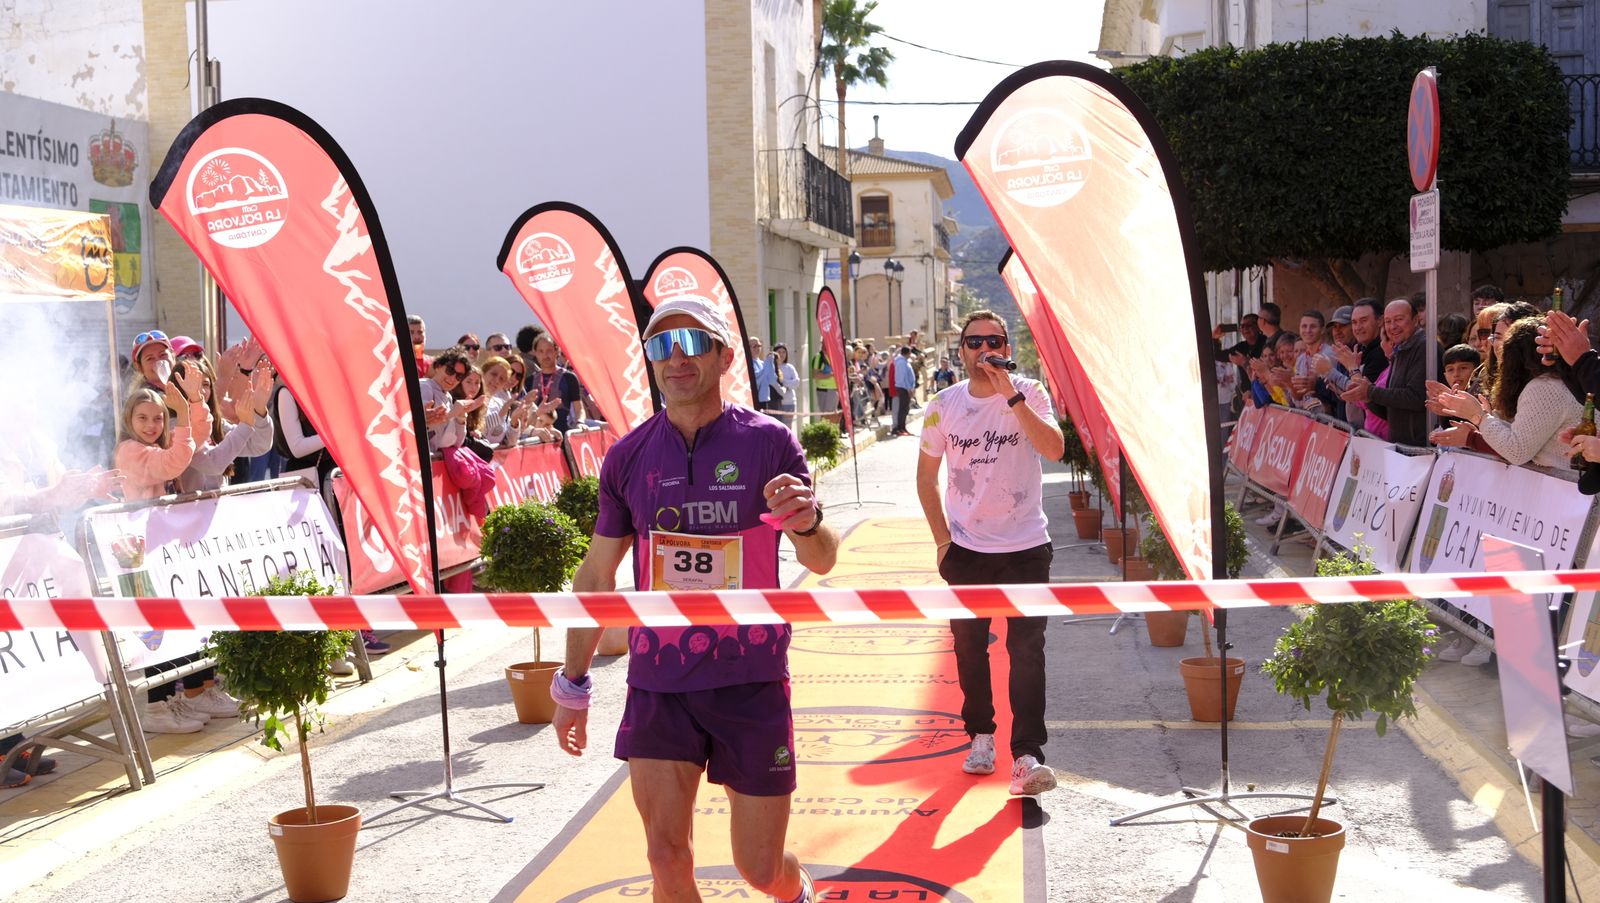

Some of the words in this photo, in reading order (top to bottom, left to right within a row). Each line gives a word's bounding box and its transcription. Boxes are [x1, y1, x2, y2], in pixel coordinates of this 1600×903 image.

[0, 171, 78, 208] TAMIENTO
[948, 433, 981, 455] Pepe
[983, 430, 1021, 452] Yepes
[968, 454, 999, 467] speaker
[682, 500, 738, 525] TBM
[1458, 494, 1545, 541] AYUNTAMIENTO
[1550, 525, 1570, 552] DE
[161, 524, 297, 565] AYUNTAMIENTO
[301, 519, 324, 538] DE
[674, 550, 713, 574] 38
[875, 797, 920, 805] de
[868, 889, 928, 901] LA
